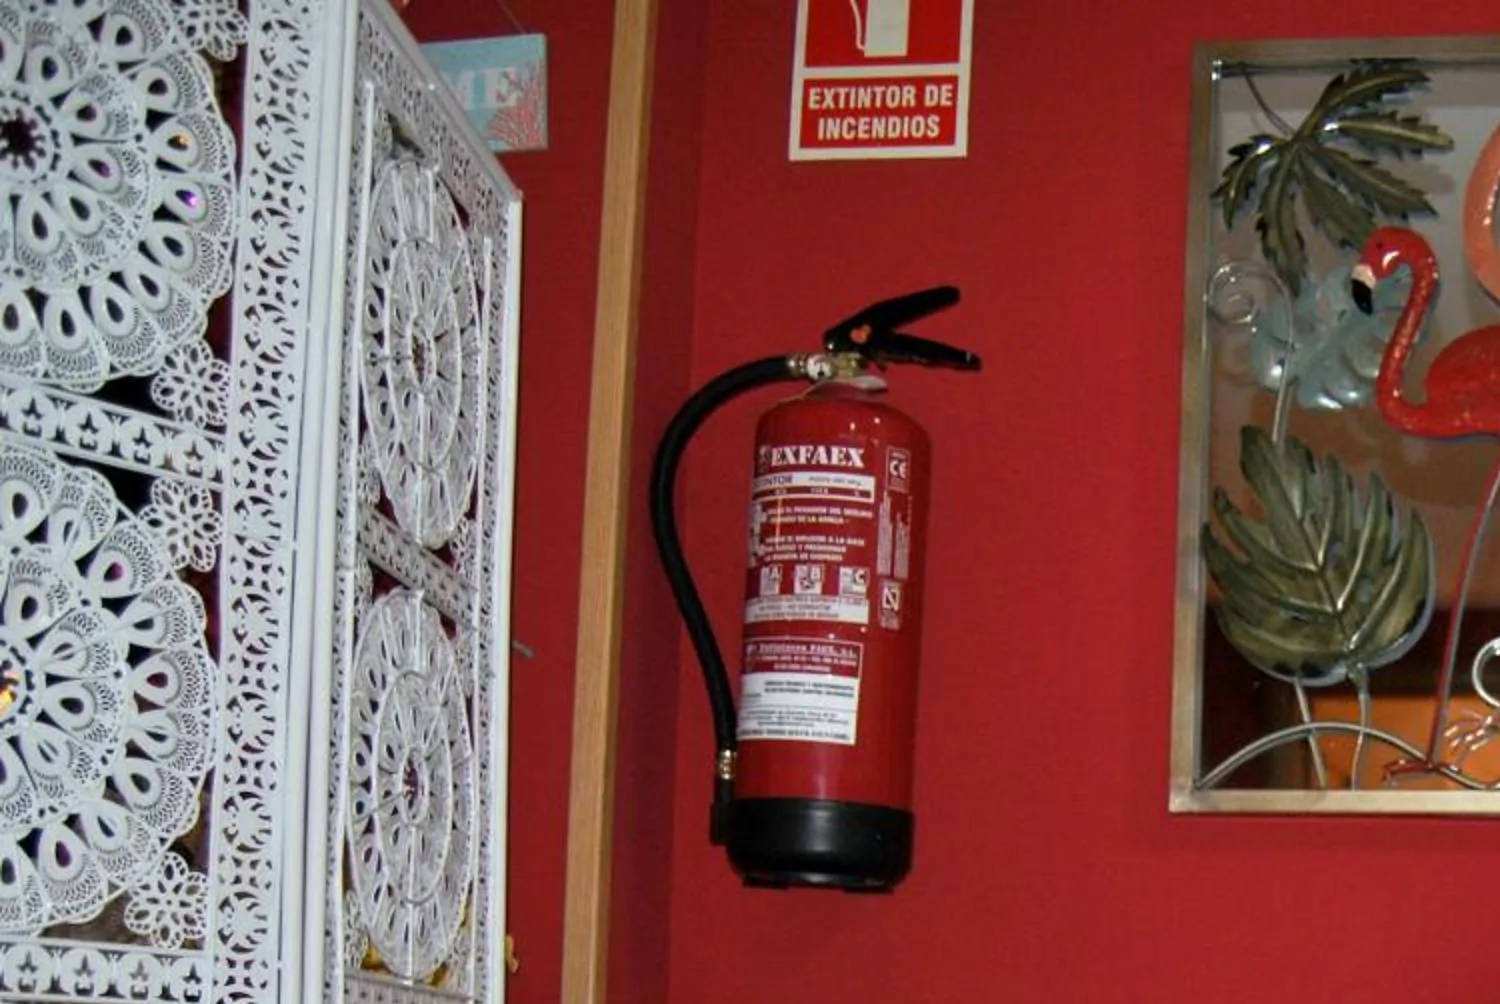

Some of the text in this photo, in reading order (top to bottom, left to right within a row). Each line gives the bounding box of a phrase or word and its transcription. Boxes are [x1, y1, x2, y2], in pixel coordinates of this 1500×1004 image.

[807, 84, 954, 110] EXTINTOR DE
[817, 115, 941, 140] INCENDIOS
